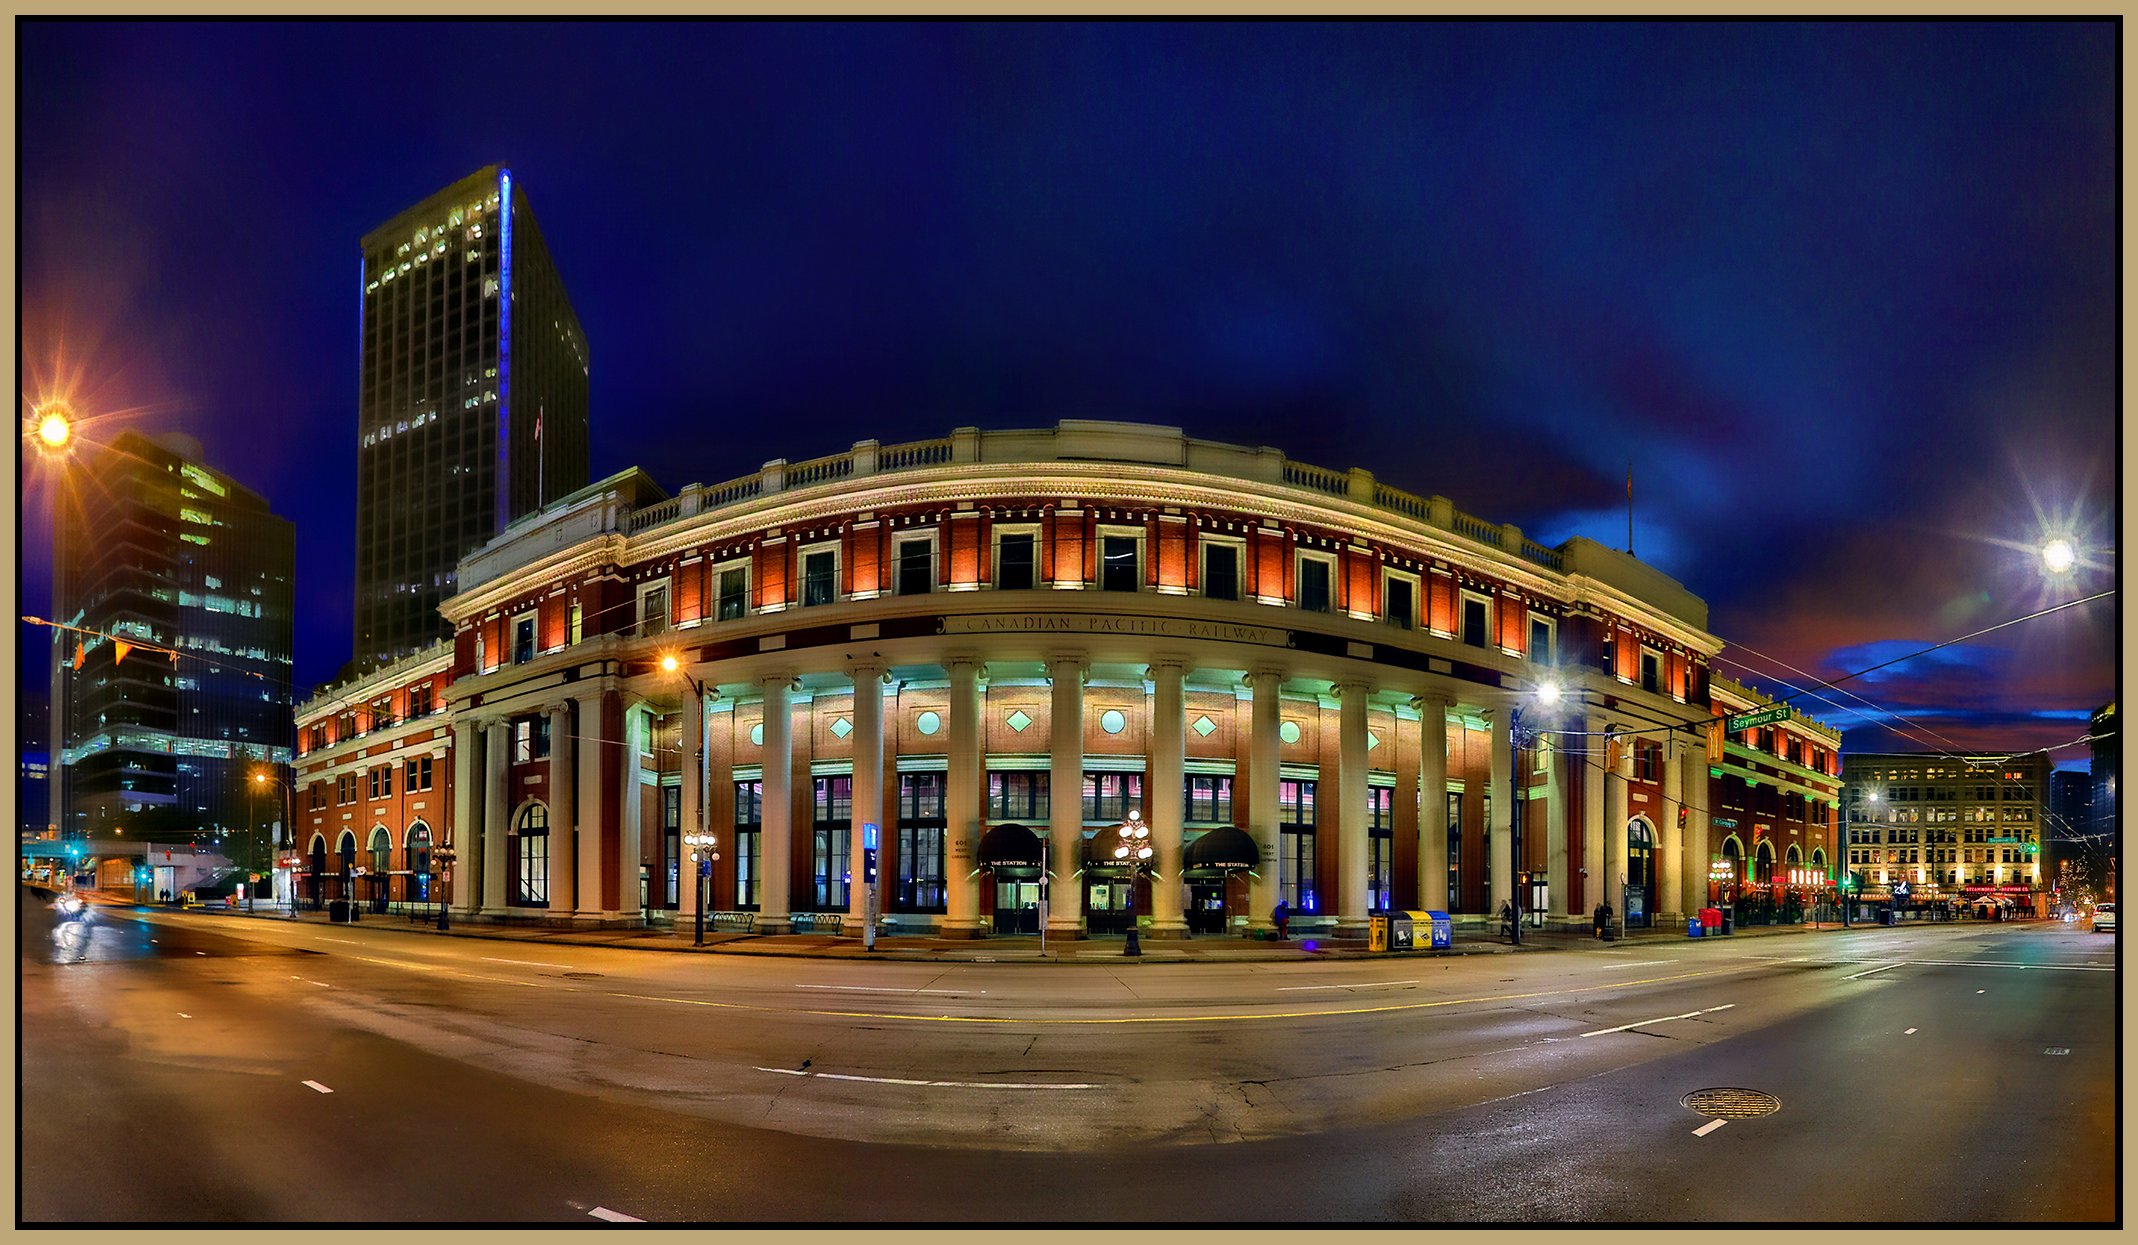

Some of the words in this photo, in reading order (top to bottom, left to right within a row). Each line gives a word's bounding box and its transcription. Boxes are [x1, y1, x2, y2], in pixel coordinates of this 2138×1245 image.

[966, 616, 1071, 630] CANADIAN
[1089, 617, 1171, 633] PACIFIC
[1189, 622, 1268, 641] RAILWAY
[1733, 712, 1772, 729] Seymour
[1775, 709, 1787, 719] St
[1791, 869, 1824, 885] ROGUE
